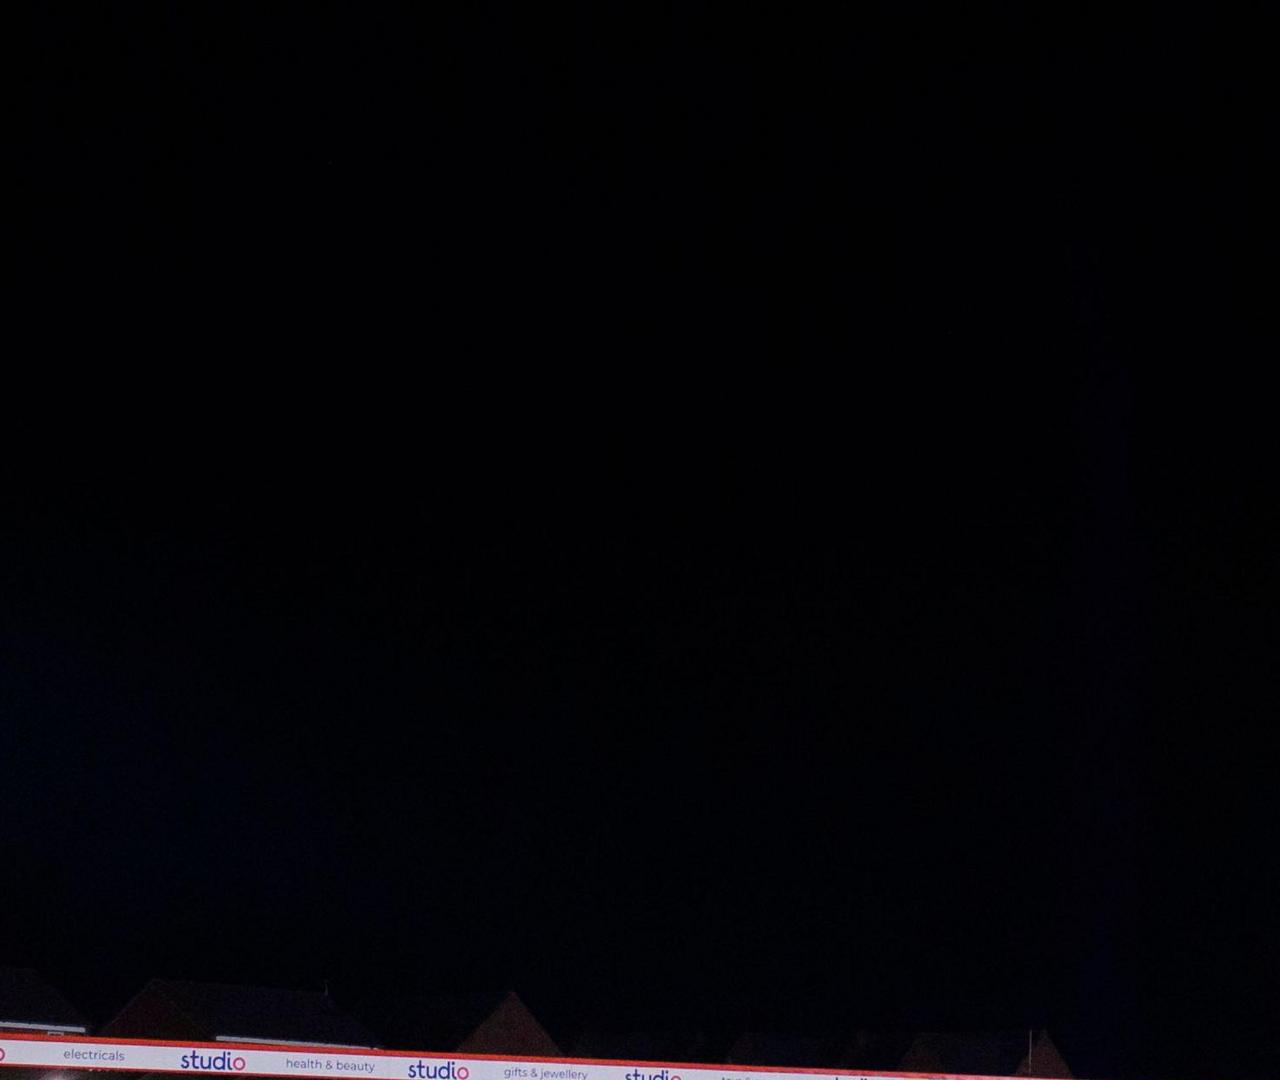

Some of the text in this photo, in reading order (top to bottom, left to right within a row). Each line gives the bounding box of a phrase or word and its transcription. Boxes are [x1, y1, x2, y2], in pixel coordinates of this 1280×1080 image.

[63, 1048, 125, 1061] electricals
[181, 1050, 246, 1071] studio
[286, 1058, 375, 1074] health & beauty
[408, 1061, 469, 1080] studio
[504, 1067, 588, 1080] gifts & jewellery
